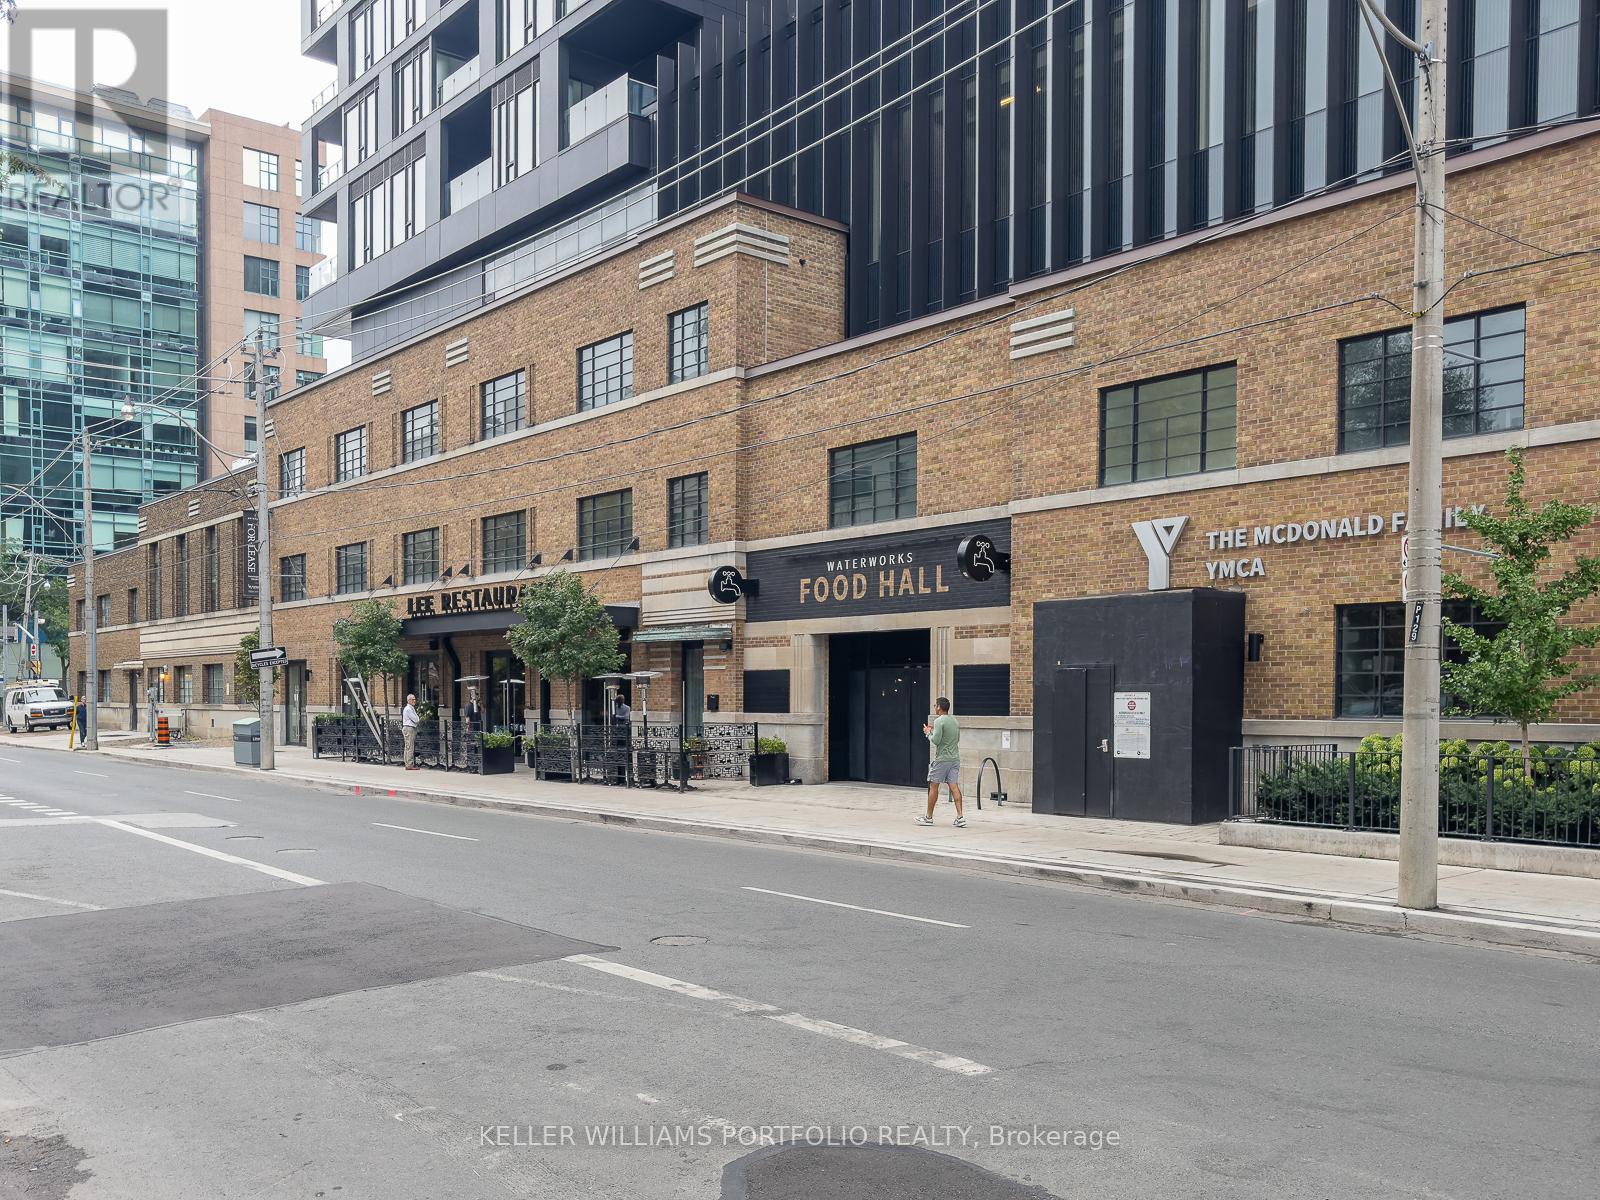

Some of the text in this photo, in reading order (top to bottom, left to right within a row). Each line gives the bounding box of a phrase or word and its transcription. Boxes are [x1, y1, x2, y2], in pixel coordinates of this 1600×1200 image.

[247, 523, 256, 542] FOR
[1206, 528, 1248, 550] THE
[1253, 515, 1384, 546] MCDONALD
[247, 545, 256, 573] LEASE
[827, 552, 913, 572] WATERWORKS
[1206, 557, 1265, 580] YMCA
[407, 583, 525, 614] LEE RESTAUR
[800, 565, 949, 604] FOOD HALL
